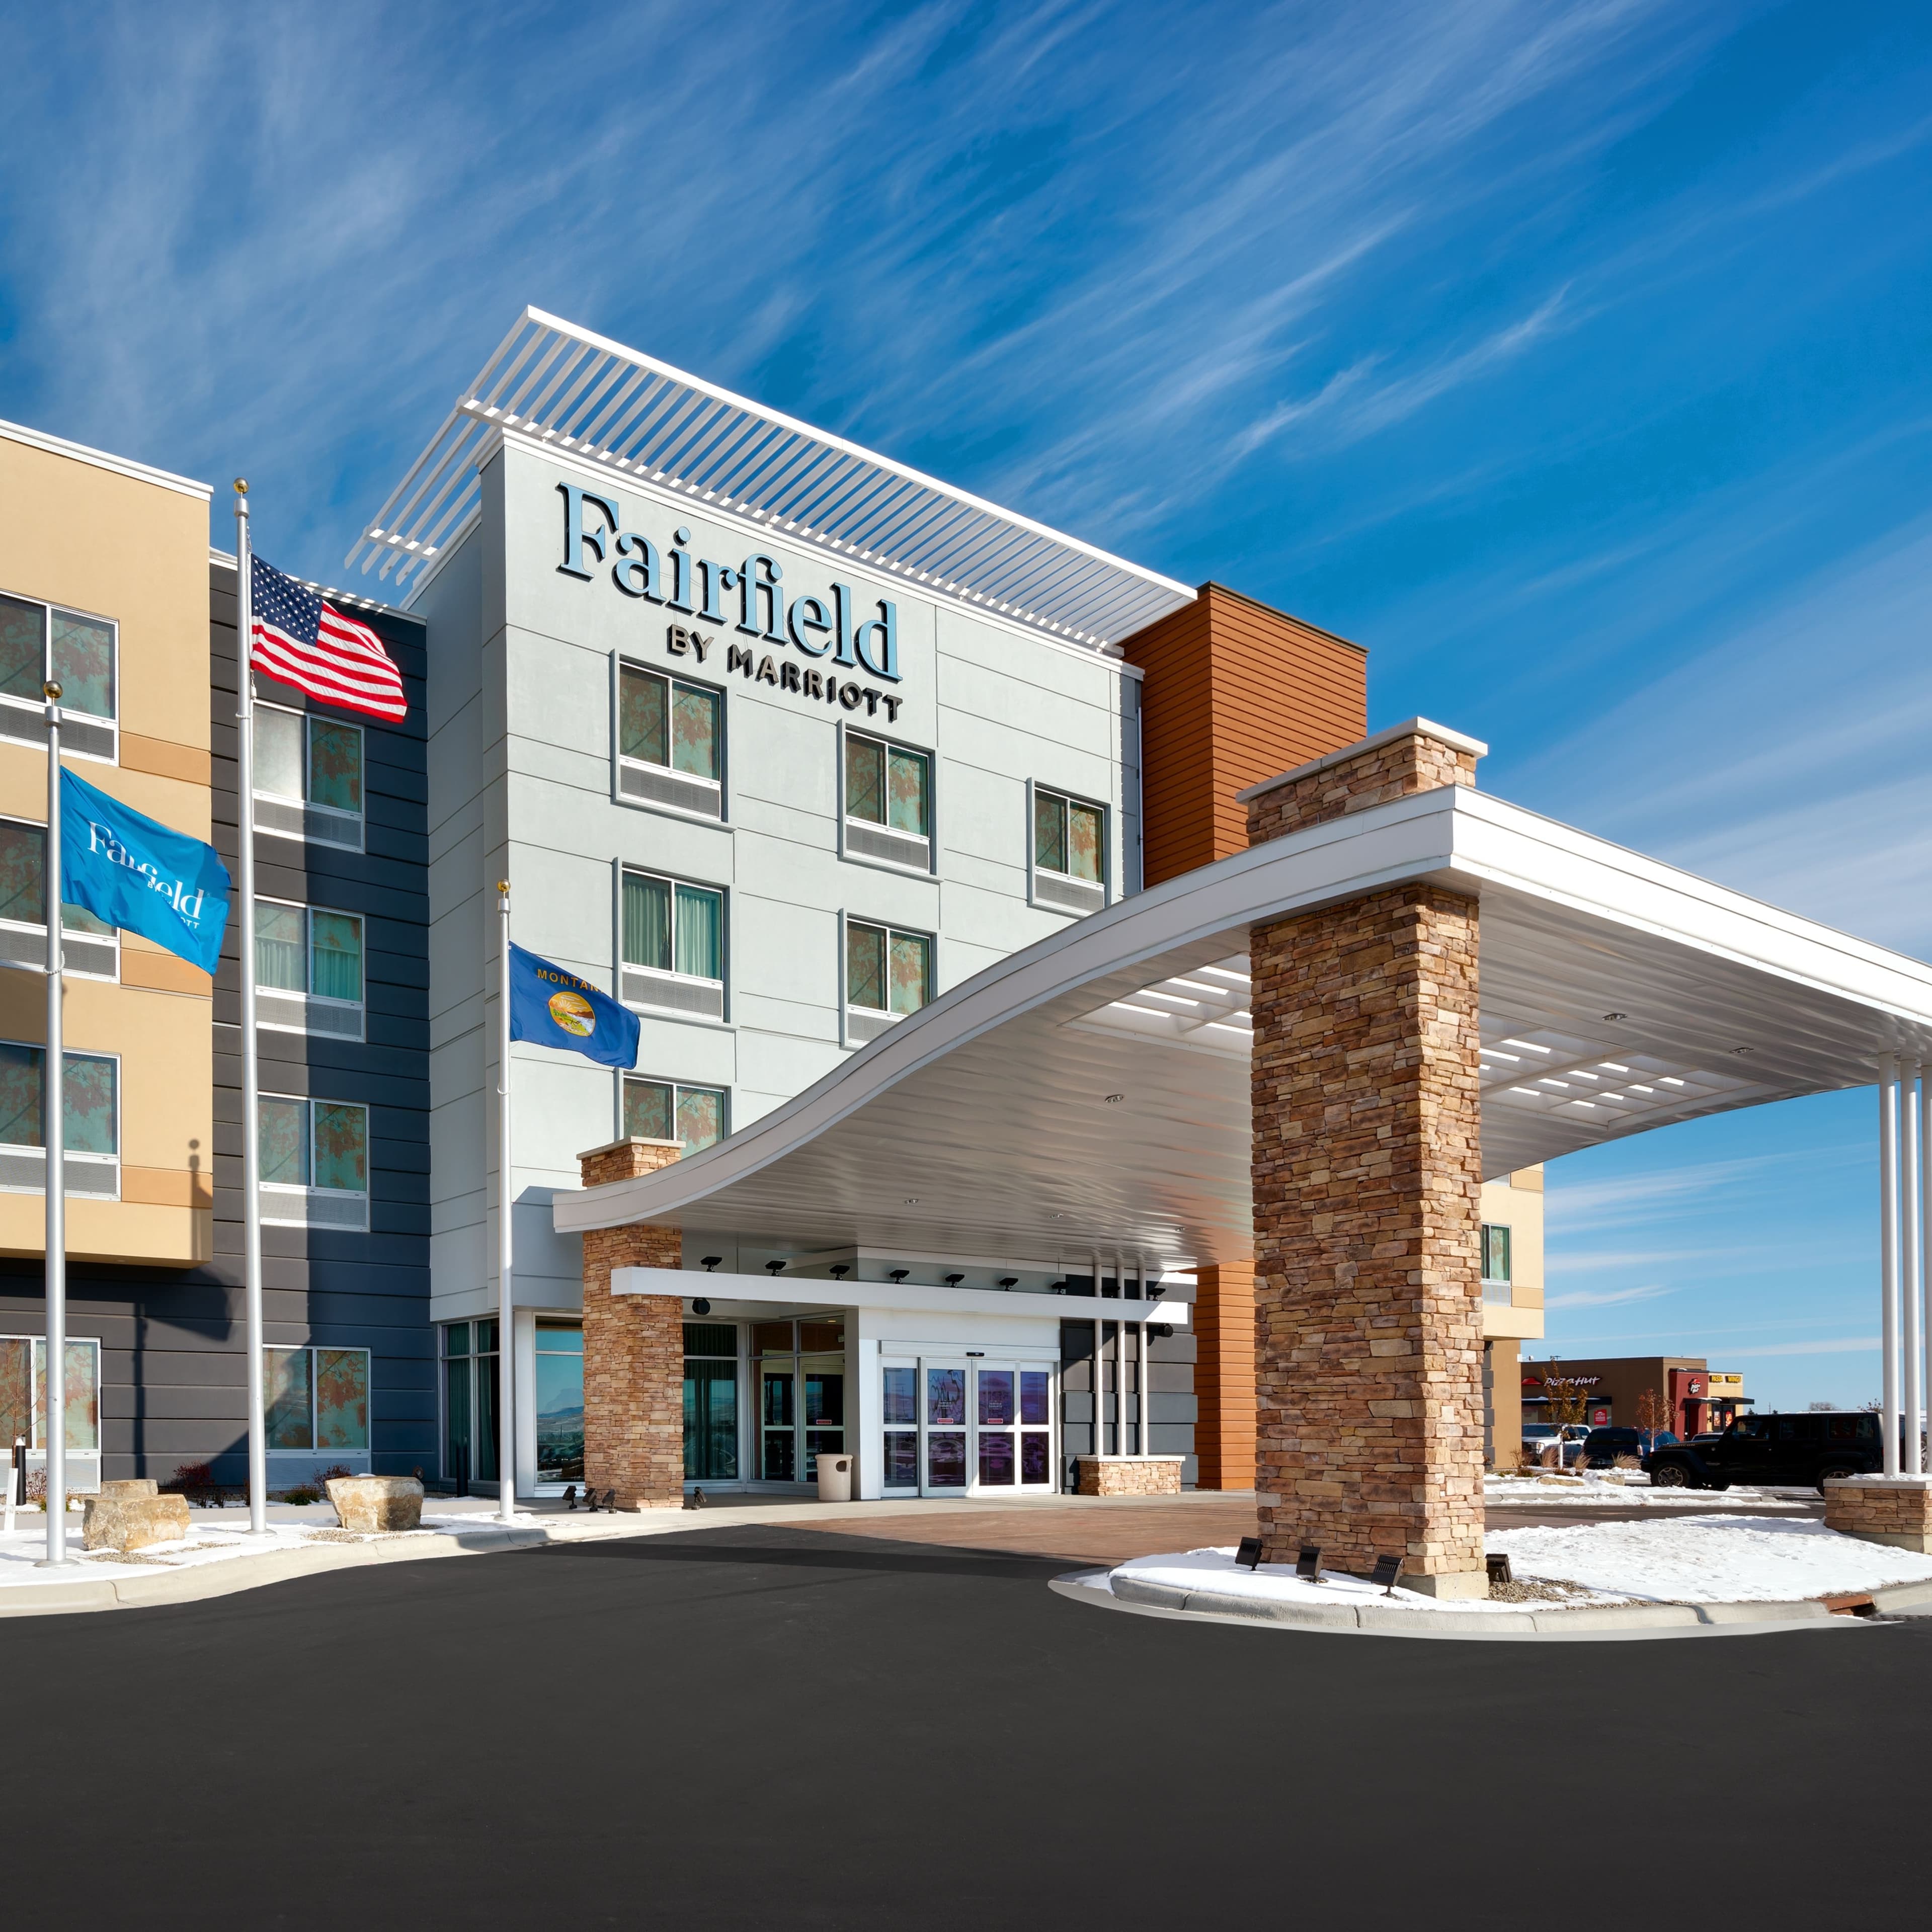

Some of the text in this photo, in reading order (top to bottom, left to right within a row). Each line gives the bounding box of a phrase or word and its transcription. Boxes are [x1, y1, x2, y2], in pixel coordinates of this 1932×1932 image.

[555, 481, 904, 683] Fairfield
[667, 624, 903, 722] BY MARRIOTT
[537, 969, 604, 993] MONTAN
[1575, 1376, 1600, 1386] Hut
